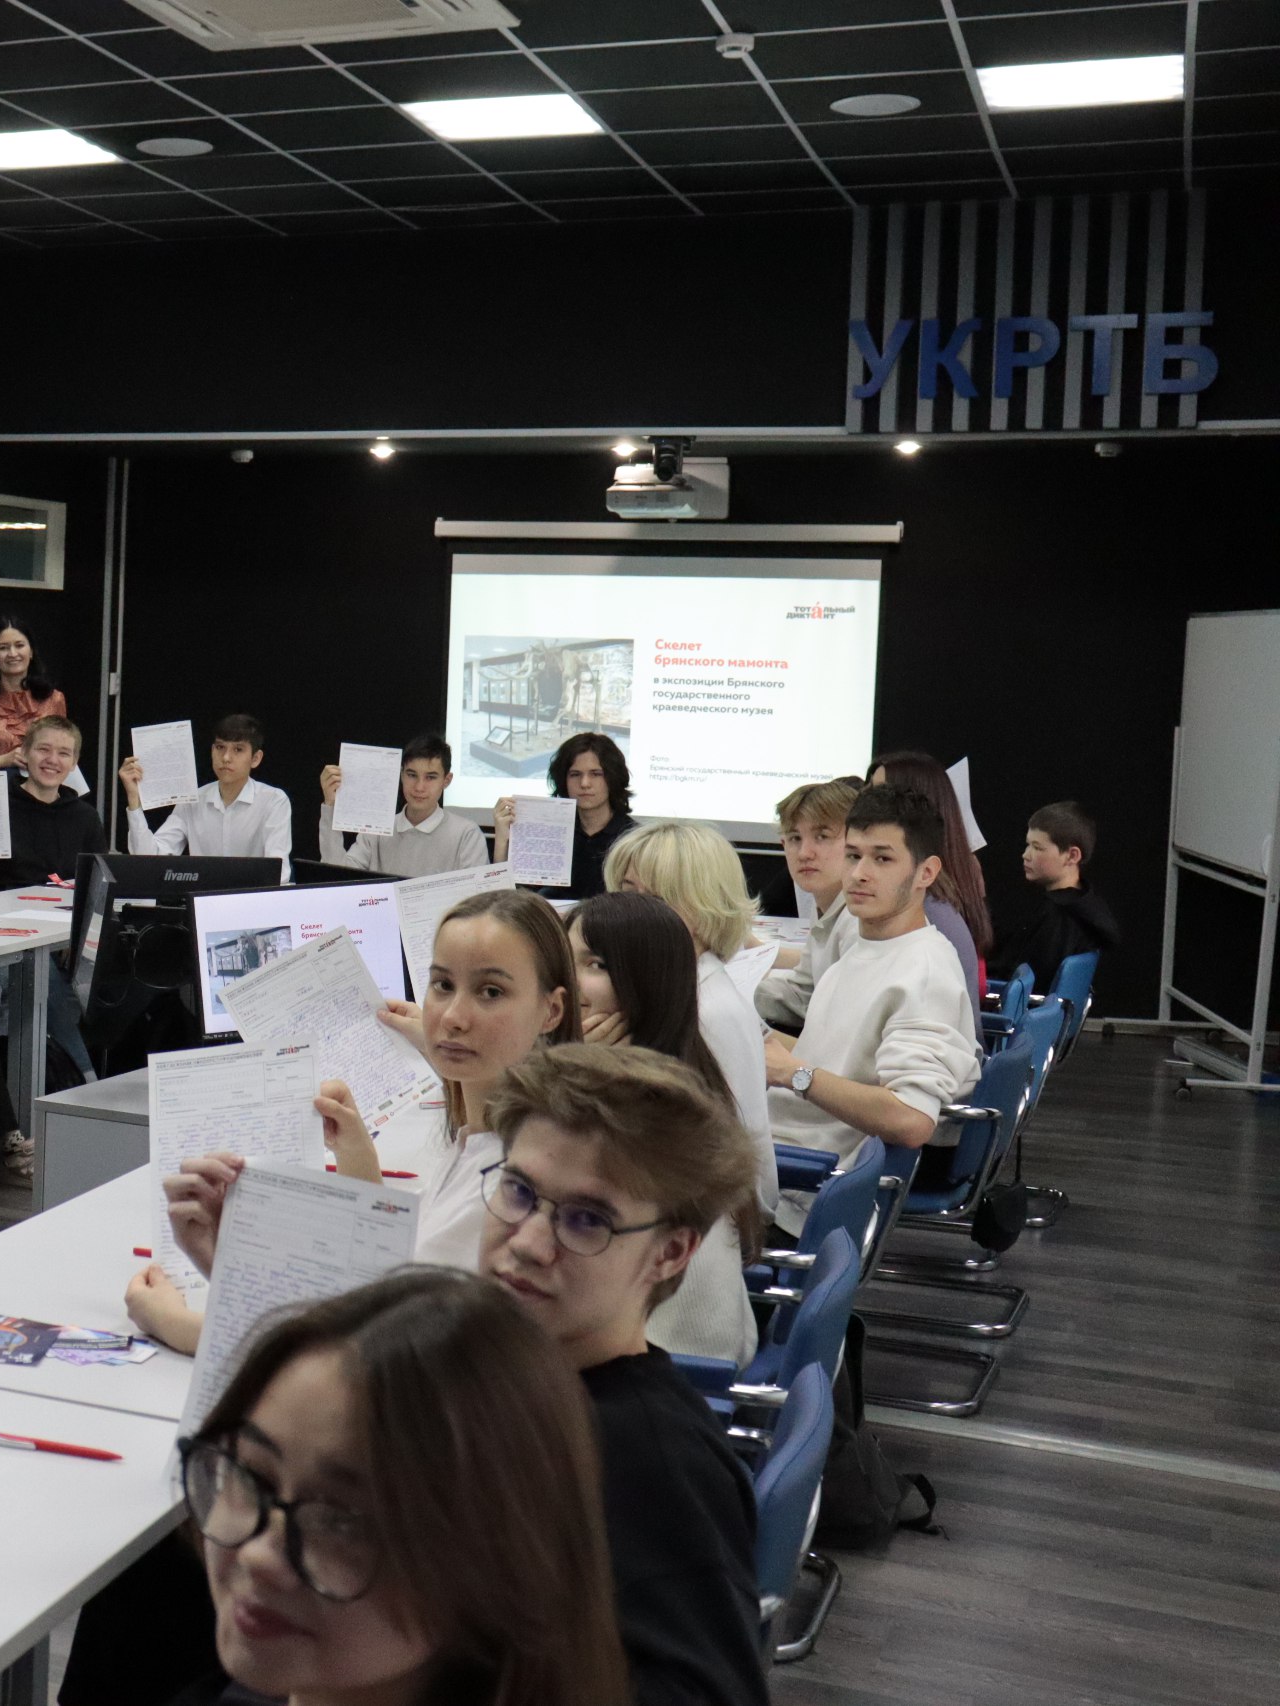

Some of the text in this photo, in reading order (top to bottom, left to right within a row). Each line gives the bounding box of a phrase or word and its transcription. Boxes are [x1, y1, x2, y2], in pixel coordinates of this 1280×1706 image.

[848, 311, 1219, 399] УКРТБ
[655, 639, 702, 651] Скелет
[654, 655, 789, 670] брянского мамонта
[662, 677, 724, 687] экспозиции
[727, 677, 785, 689] Брянского
[653, 689, 751, 701] государственного
[652, 703, 773, 716] краеведческого музея
[686, 767, 750, 776] государственный
[752, 770, 809, 779] краеведческий
[164, 869, 199, 881] iiyama
